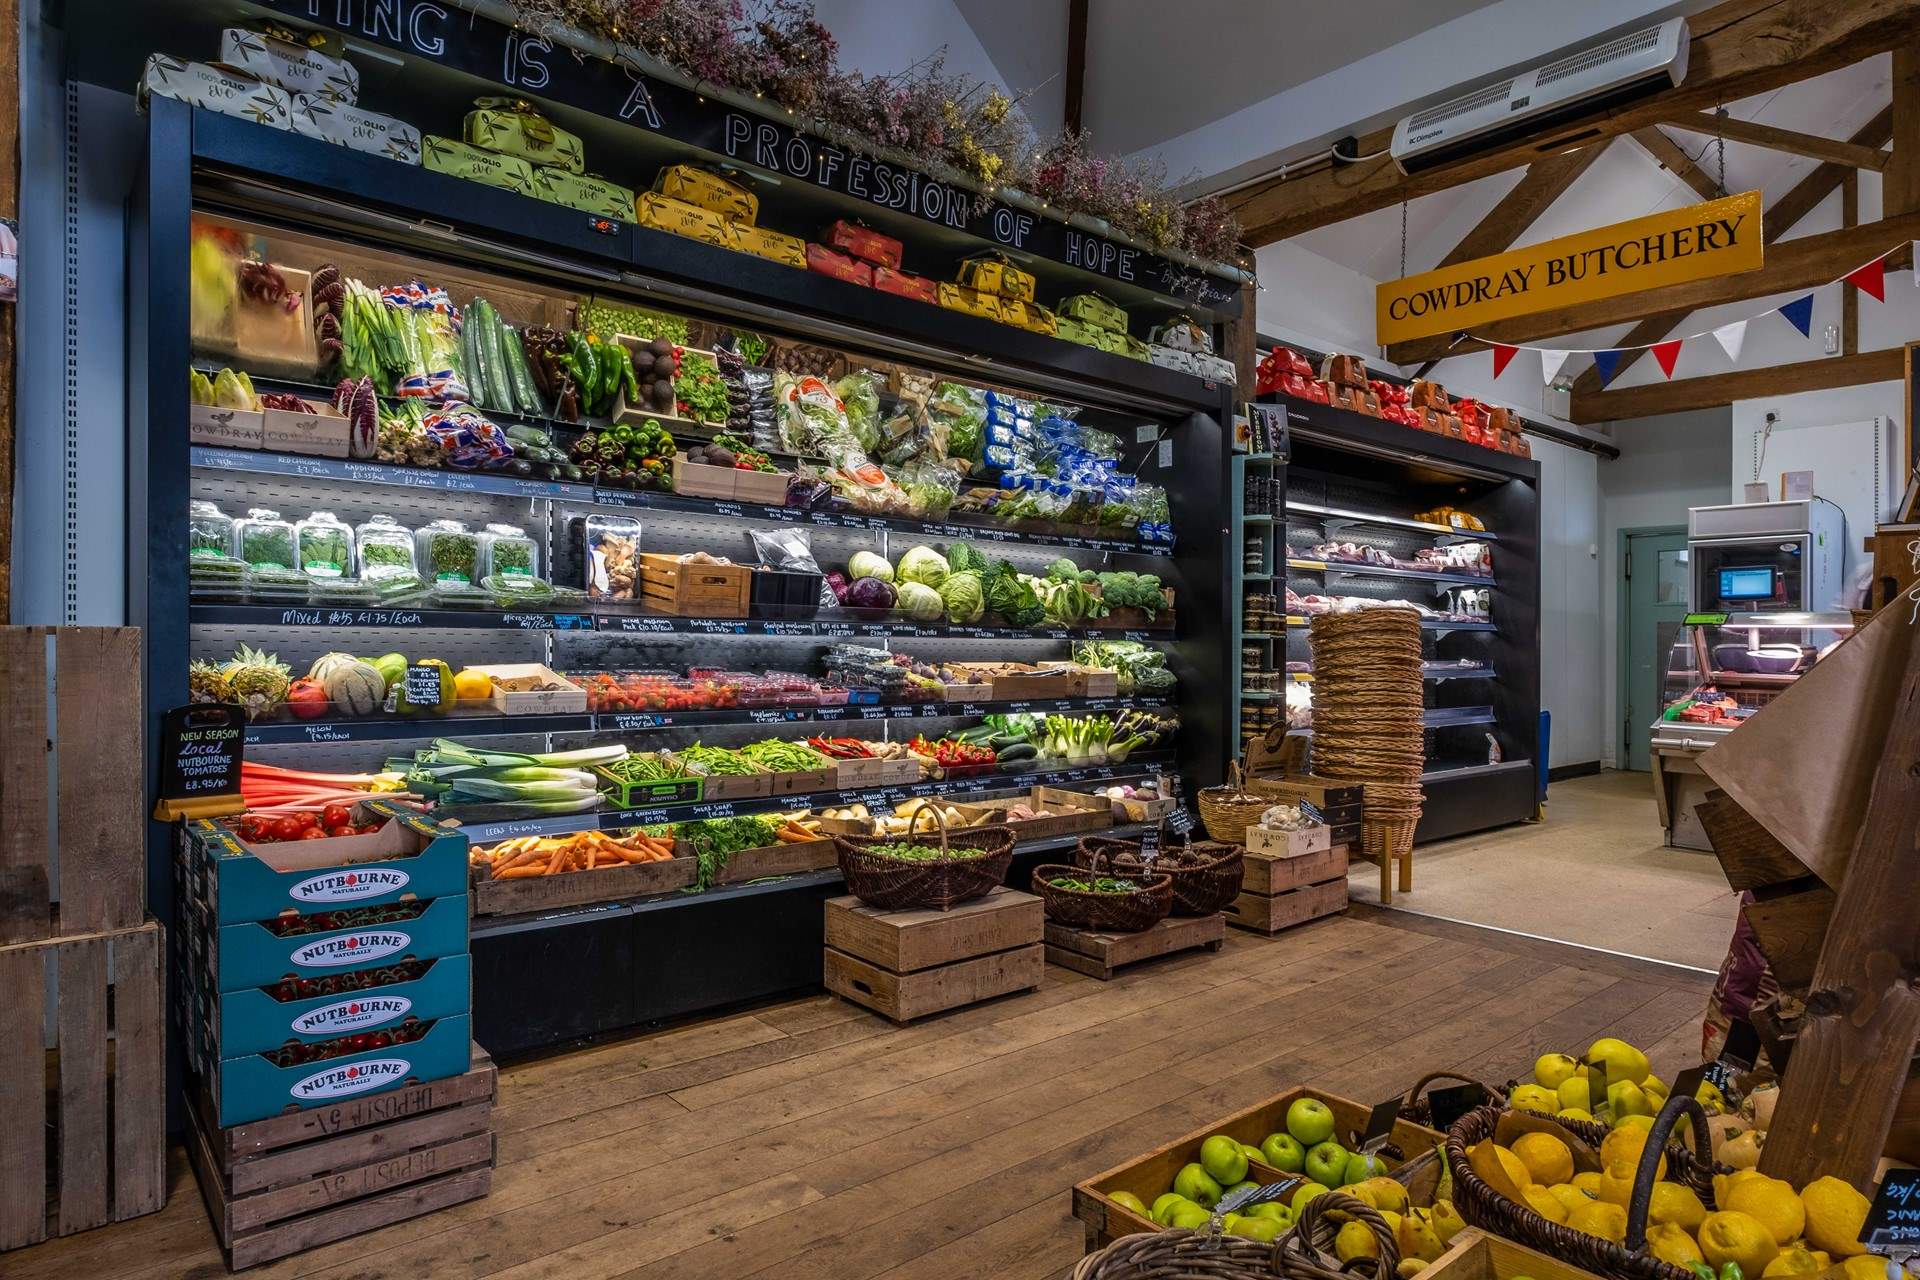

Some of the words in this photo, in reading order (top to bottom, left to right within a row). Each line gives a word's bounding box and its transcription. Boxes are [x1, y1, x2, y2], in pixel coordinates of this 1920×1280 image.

[1416, 130, 1443, 143] Dimplex
[619, 78, 662, 129] A
[725, 113, 967, 229] PROFESSION
[995, 207, 1034, 248] OF
[1389, 264, 1536, 322] COWDRAY
[1546, 214, 1745, 288] BUTCHERY
[192, 424, 264, 441] OWDRAY
[282, 609, 322, 625] Mixed
[180, 730, 202, 742] NEW
[206, 729, 239, 740] SEASON
[178, 755, 232, 768] NUTBOURNE
[183, 764, 228, 776] TOMATOES
[300, 872, 401, 897] NUTBOURNE
[332, 885, 370, 895] NATURALLY
[302, 934, 402, 962] NUTBOURNE
[333, 948, 372, 959] NATURALLY
[302, 1001, 403, 1030] NUTBOURNE
[334, 1014, 373, 1026] NATURALLY
[302, 1064, 402, 1095] NUTBOURNE
[332, 1077, 372, 1090] NATURALLY
[352, 1087, 433, 1126] DEPOSIT
